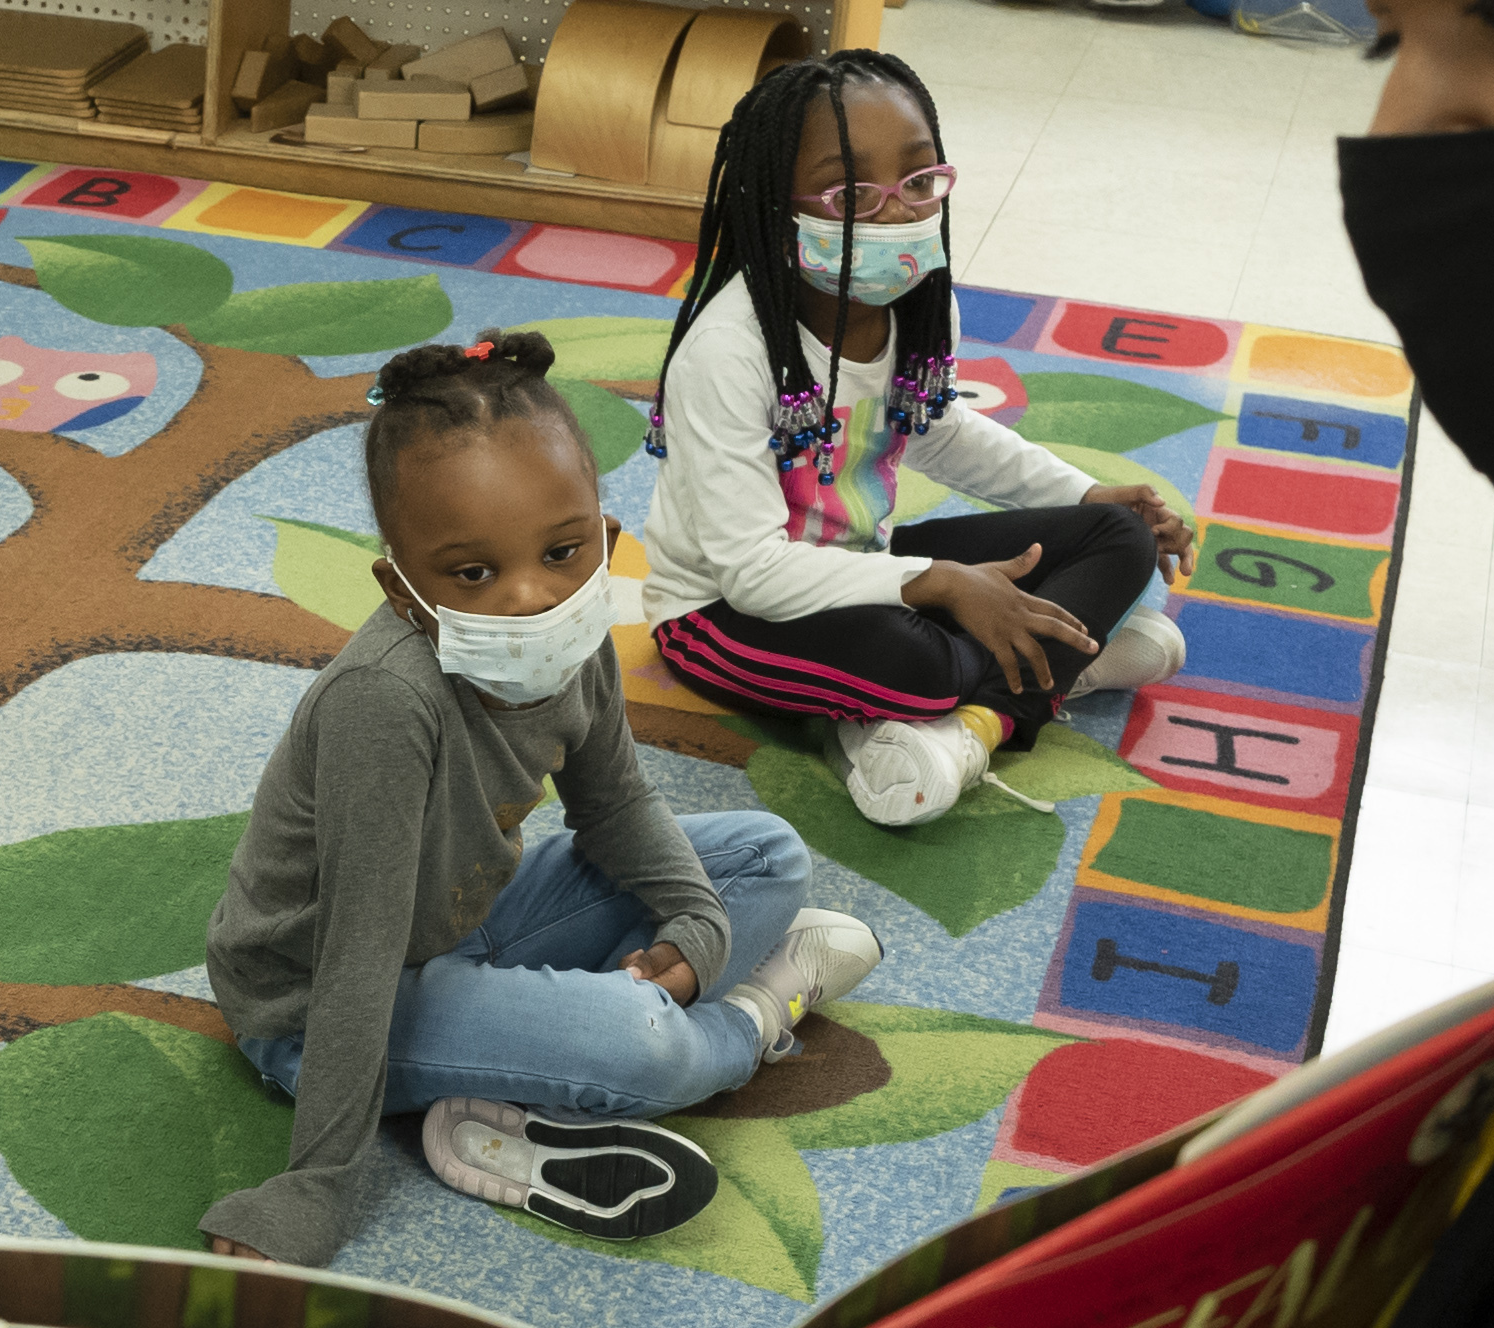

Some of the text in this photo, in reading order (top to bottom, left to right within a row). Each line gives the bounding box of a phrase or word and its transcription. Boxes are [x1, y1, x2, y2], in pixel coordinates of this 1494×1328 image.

[57, 177, 131, 207] B
[387, 224, 466, 252] C
[1101, 317, 1177, 359] E
[1252, 410, 1361, 451] F
[1215, 547, 1336, 594] G
[1160, 715, 1299, 786] H
[1093, 937, 1239, 1007] I
